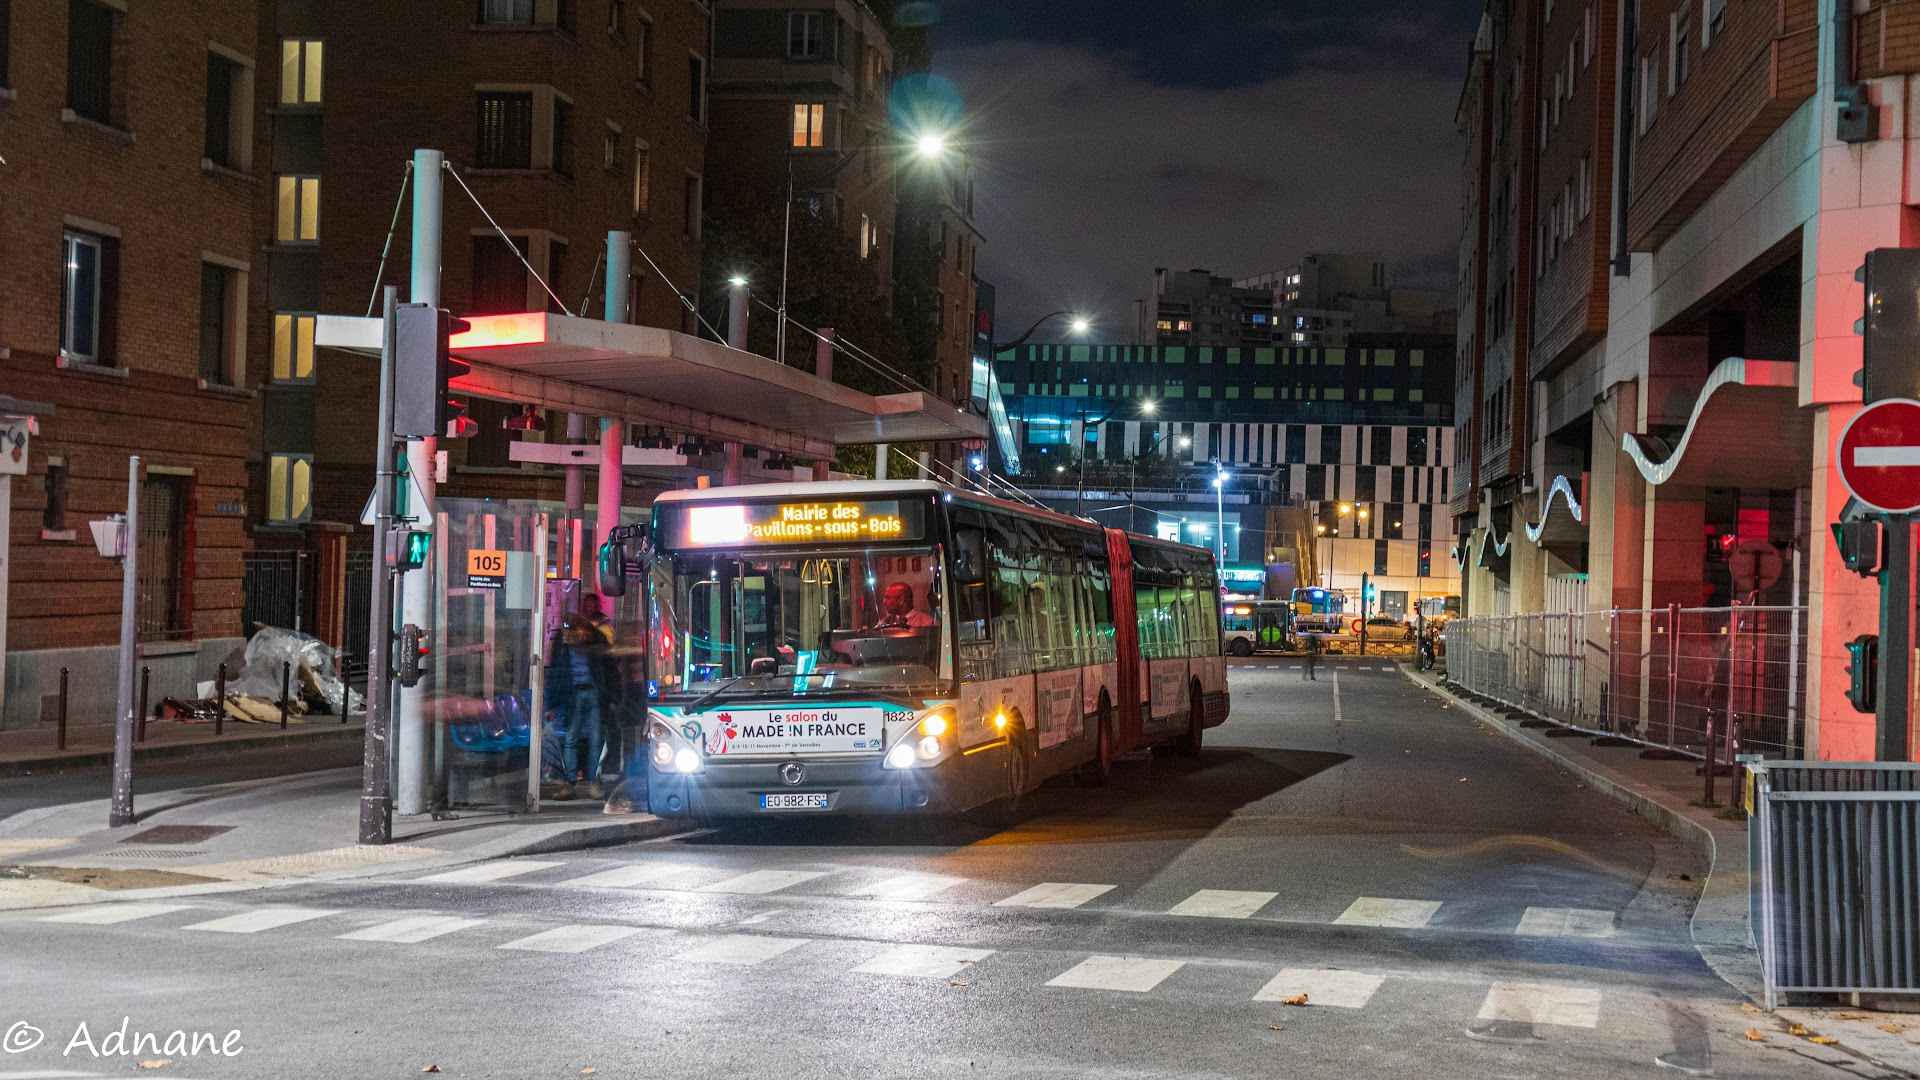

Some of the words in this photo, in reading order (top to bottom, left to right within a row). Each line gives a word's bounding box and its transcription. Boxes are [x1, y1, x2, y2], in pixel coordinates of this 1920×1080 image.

[783, 505, 828, 521] Mairie
[832, 503, 860, 519] des
[474, 556, 501, 570] 105
[769, 712, 782, 723] Le
[786, 711, 818, 723] salon
[822, 711, 837, 721] du
[885, 711, 914, 722] 1823
[742, 726, 784, 738] MADE
[808, 723, 866, 736] FRANCE
